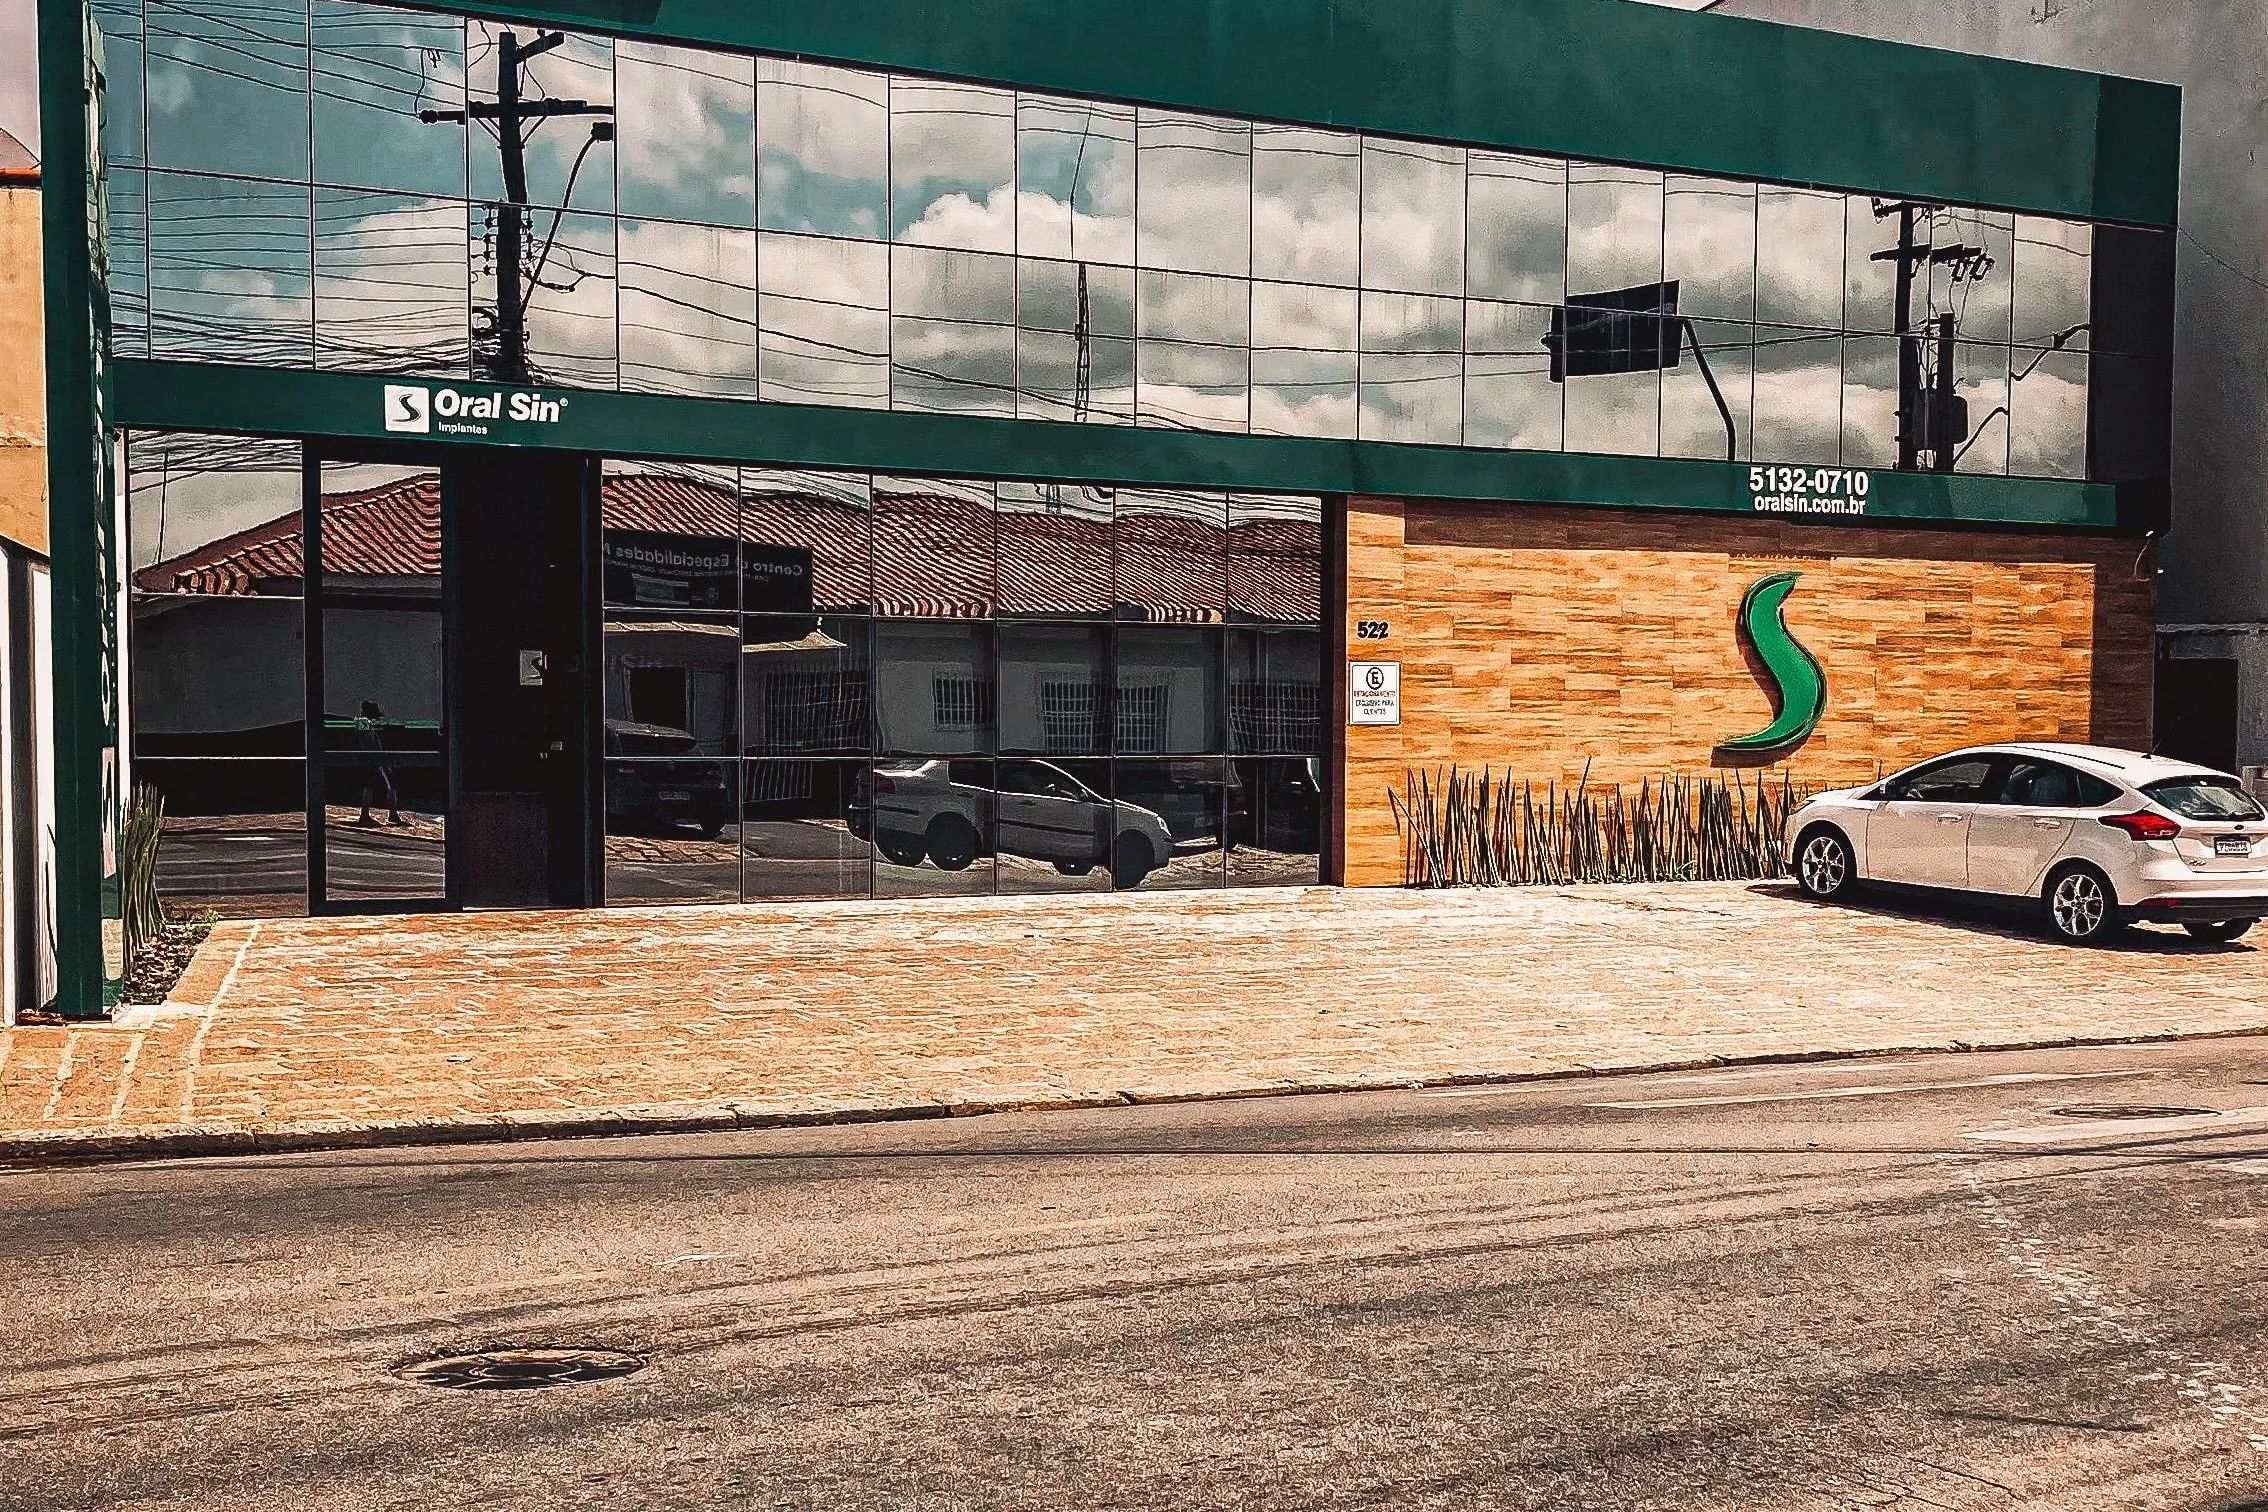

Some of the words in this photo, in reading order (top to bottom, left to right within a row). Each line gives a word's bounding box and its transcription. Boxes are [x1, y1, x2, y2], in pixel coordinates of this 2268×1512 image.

[434, 388, 502, 418] Oral
[438, 422, 488, 435] Implantes
[1749, 466, 1869, 496] 5132-0710
[1754, 493, 1866, 515] oralsin.com.br
[1357, 621, 1389, 639] 522
